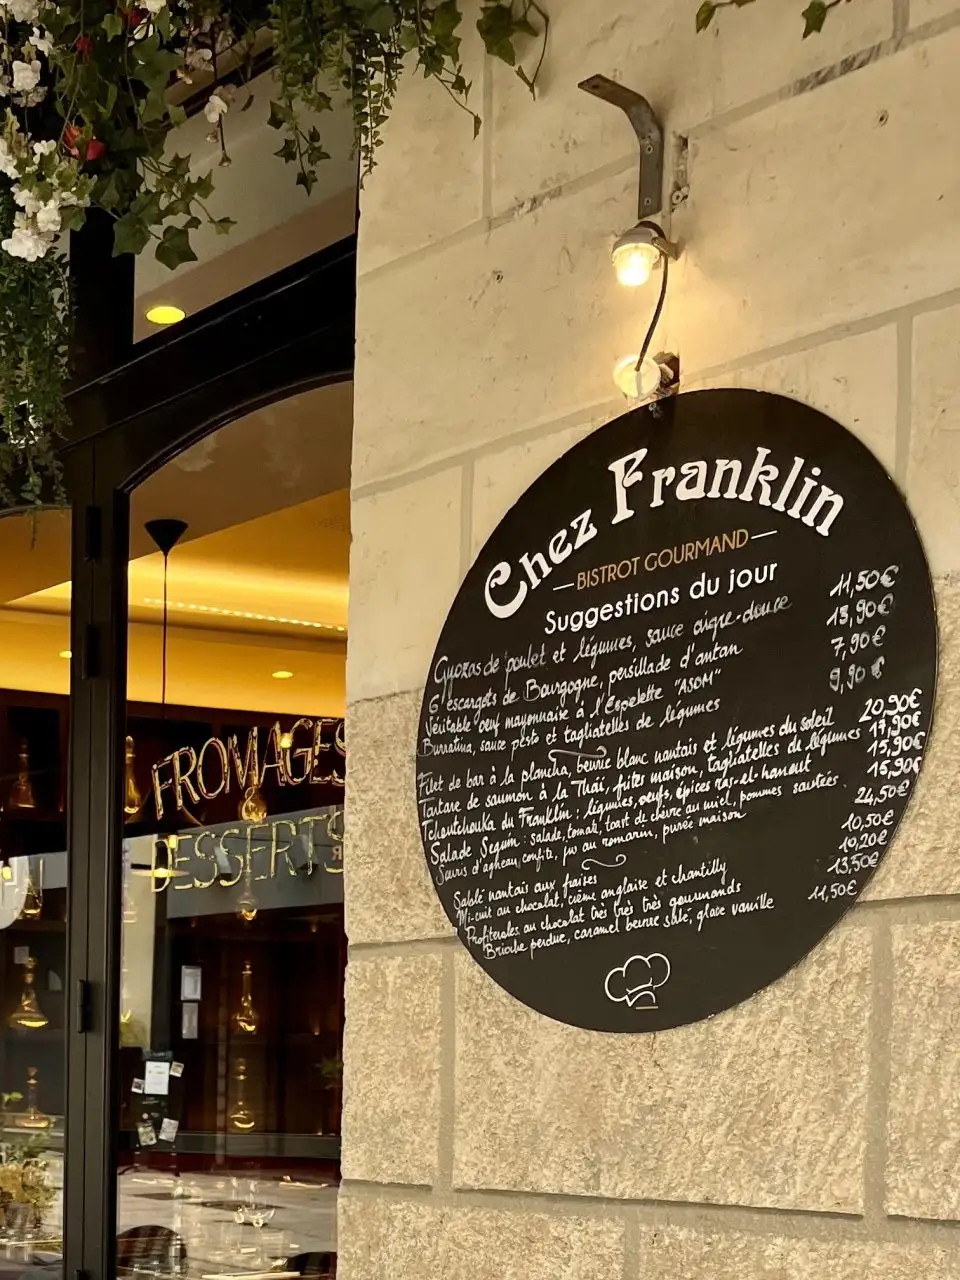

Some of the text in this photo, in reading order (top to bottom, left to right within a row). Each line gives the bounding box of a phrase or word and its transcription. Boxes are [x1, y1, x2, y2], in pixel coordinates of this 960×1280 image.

[484, 446, 844, 619] Chez Franklin
[576, 528, 749, 591] BISTROT GOURMAND
[434, 565, 899, 703] Gyozas de poulet et légumes, sauce aigre-douce 11,50€
[544, 562, 779, 635] Suggestions du jour
[428, 593, 893, 725] 6 escargots de Bourgogne, persillade d'antan 13,90€
[151, 718, 345, 820] FROMAGES
[417, 734, 476, 757] Burratina,
[480, 738, 506, 752] sauce
[511, 729, 540, 761] pesto
[546, 727, 558, 745] et
[564, 717, 629, 749] tagliatelles
[636, 712, 655, 730] de
[659, 698, 721, 728] légumes
[417, 688, 922, 797] Filet de bar à la plancha, beurre blanc nantais et légumes du soleil 20,90€
[419, 797, 462, 818] Tartare
[467, 792, 480, 810] de
[485, 790, 533, 808] saumon
[539, 783, 548, 800] à
[552, 781, 569, 803] la
[612, 771, 645, 800] frites
[650, 764, 703, 784] maison,
[707, 740, 780, 778] tagliatelles
[787, 734, 802, 755] de
[805, 727, 861, 757] légumes
[869, 711, 921, 739] 17,90€
[425, 715, 471, 737] Véritable
[505, 706, 569, 736] mayonnaise
[576, 700, 584, 718] à
[421, 811, 496, 843] Tchoutchouka
[501, 812, 514, 831] du
[518, 802, 573, 829] Franklin
[583, 796, 638, 822] légumes,
[675, 780, 711, 805] épices
[867, 732, 926, 757] 15,90€
[430, 840, 472, 865] Salade
[480, 832, 521, 860] Seguin
[530, 826, 566, 846] salade,
[567, 819, 602, 838] tomate,
[605, 811, 631, 831] toast
[634, 809, 648, 825] de
[650, 804, 682, 822] chèvre
[685, 801, 700, 814] au
[703, 790, 737, 809] miel,
[740, 785, 782, 809] pommes
[867, 756, 922, 779] 15,90€
[436, 864, 467, 886] Souris
[522, 849, 558, 872] confite,
[582, 840, 597, 852] au
[602, 824, 658, 848] romarin,
[662, 816, 694, 843] purée
[698, 811, 747, 827] maison
[854, 779, 910, 807] 24,50€
[151, 810, 344, 892] DESSERTS
[453, 809, 894, 911] Sablé nantais aux fraises 10,50€
[456, 829, 888, 928] Mi-cuit au chocolat, crème anglaise et chantilly 10,20€
[466, 851, 879, 948] Profiteroles au chocolat très très très gourmands 13,50€
[483, 940, 528, 960] Brioche
[530, 931, 571, 960] perdue,
[574, 917, 619, 940] caramel
[626, 914, 660, 932] beurre
[697, 903, 726, 932] glace
[732, 893, 775, 916] vanille
[808, 880, 858, 903] 11,50€
